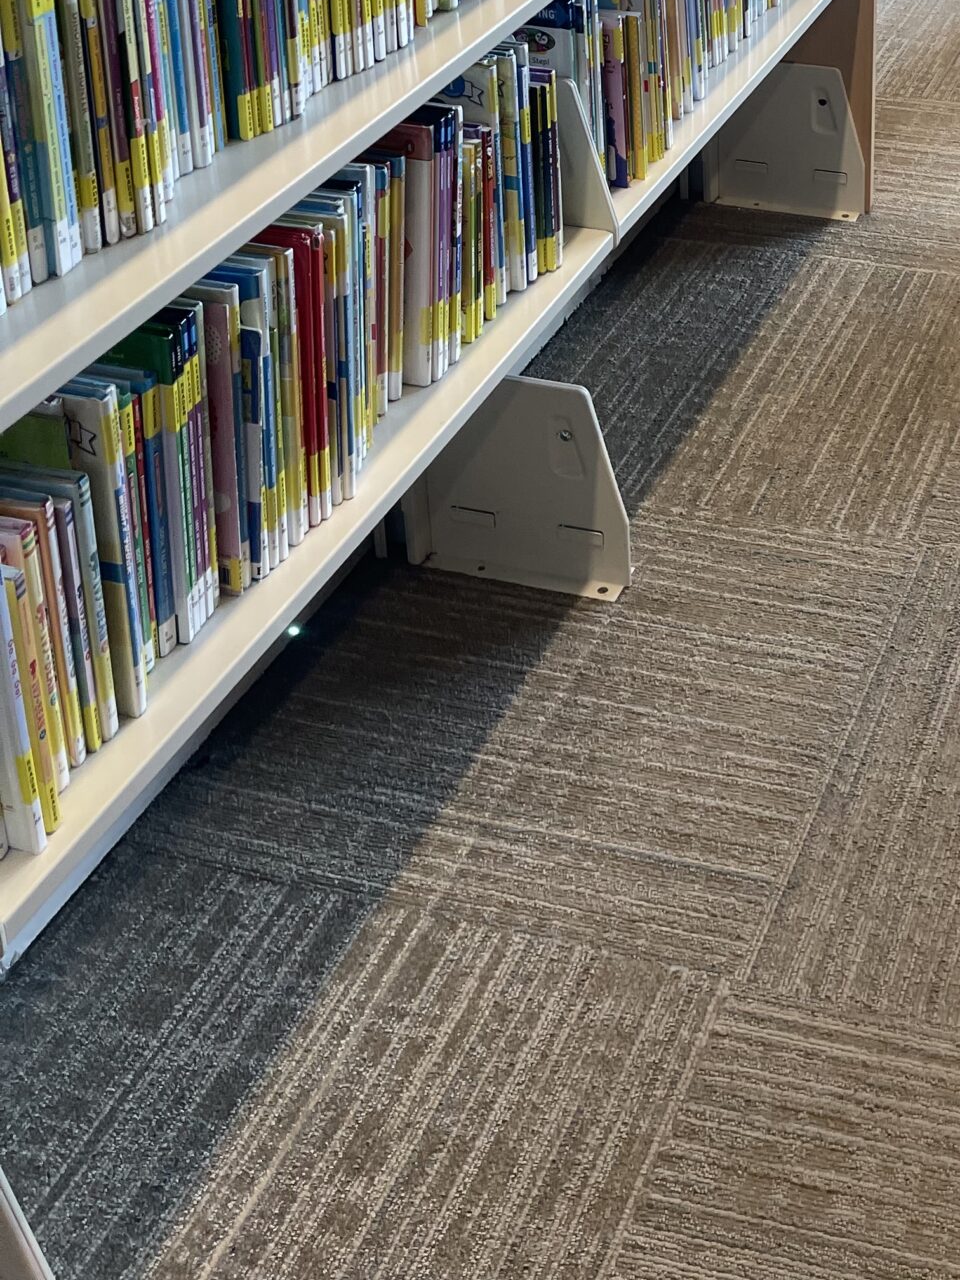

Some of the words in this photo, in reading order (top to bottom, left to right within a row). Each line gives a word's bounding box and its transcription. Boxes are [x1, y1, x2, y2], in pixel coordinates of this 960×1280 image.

[73, 12, 82, 67] DINOSAUR
[78, 70, 88, 117] HUNTER
[27, 759, 36, 794] READER
[49, 787, 58, 823] READER
